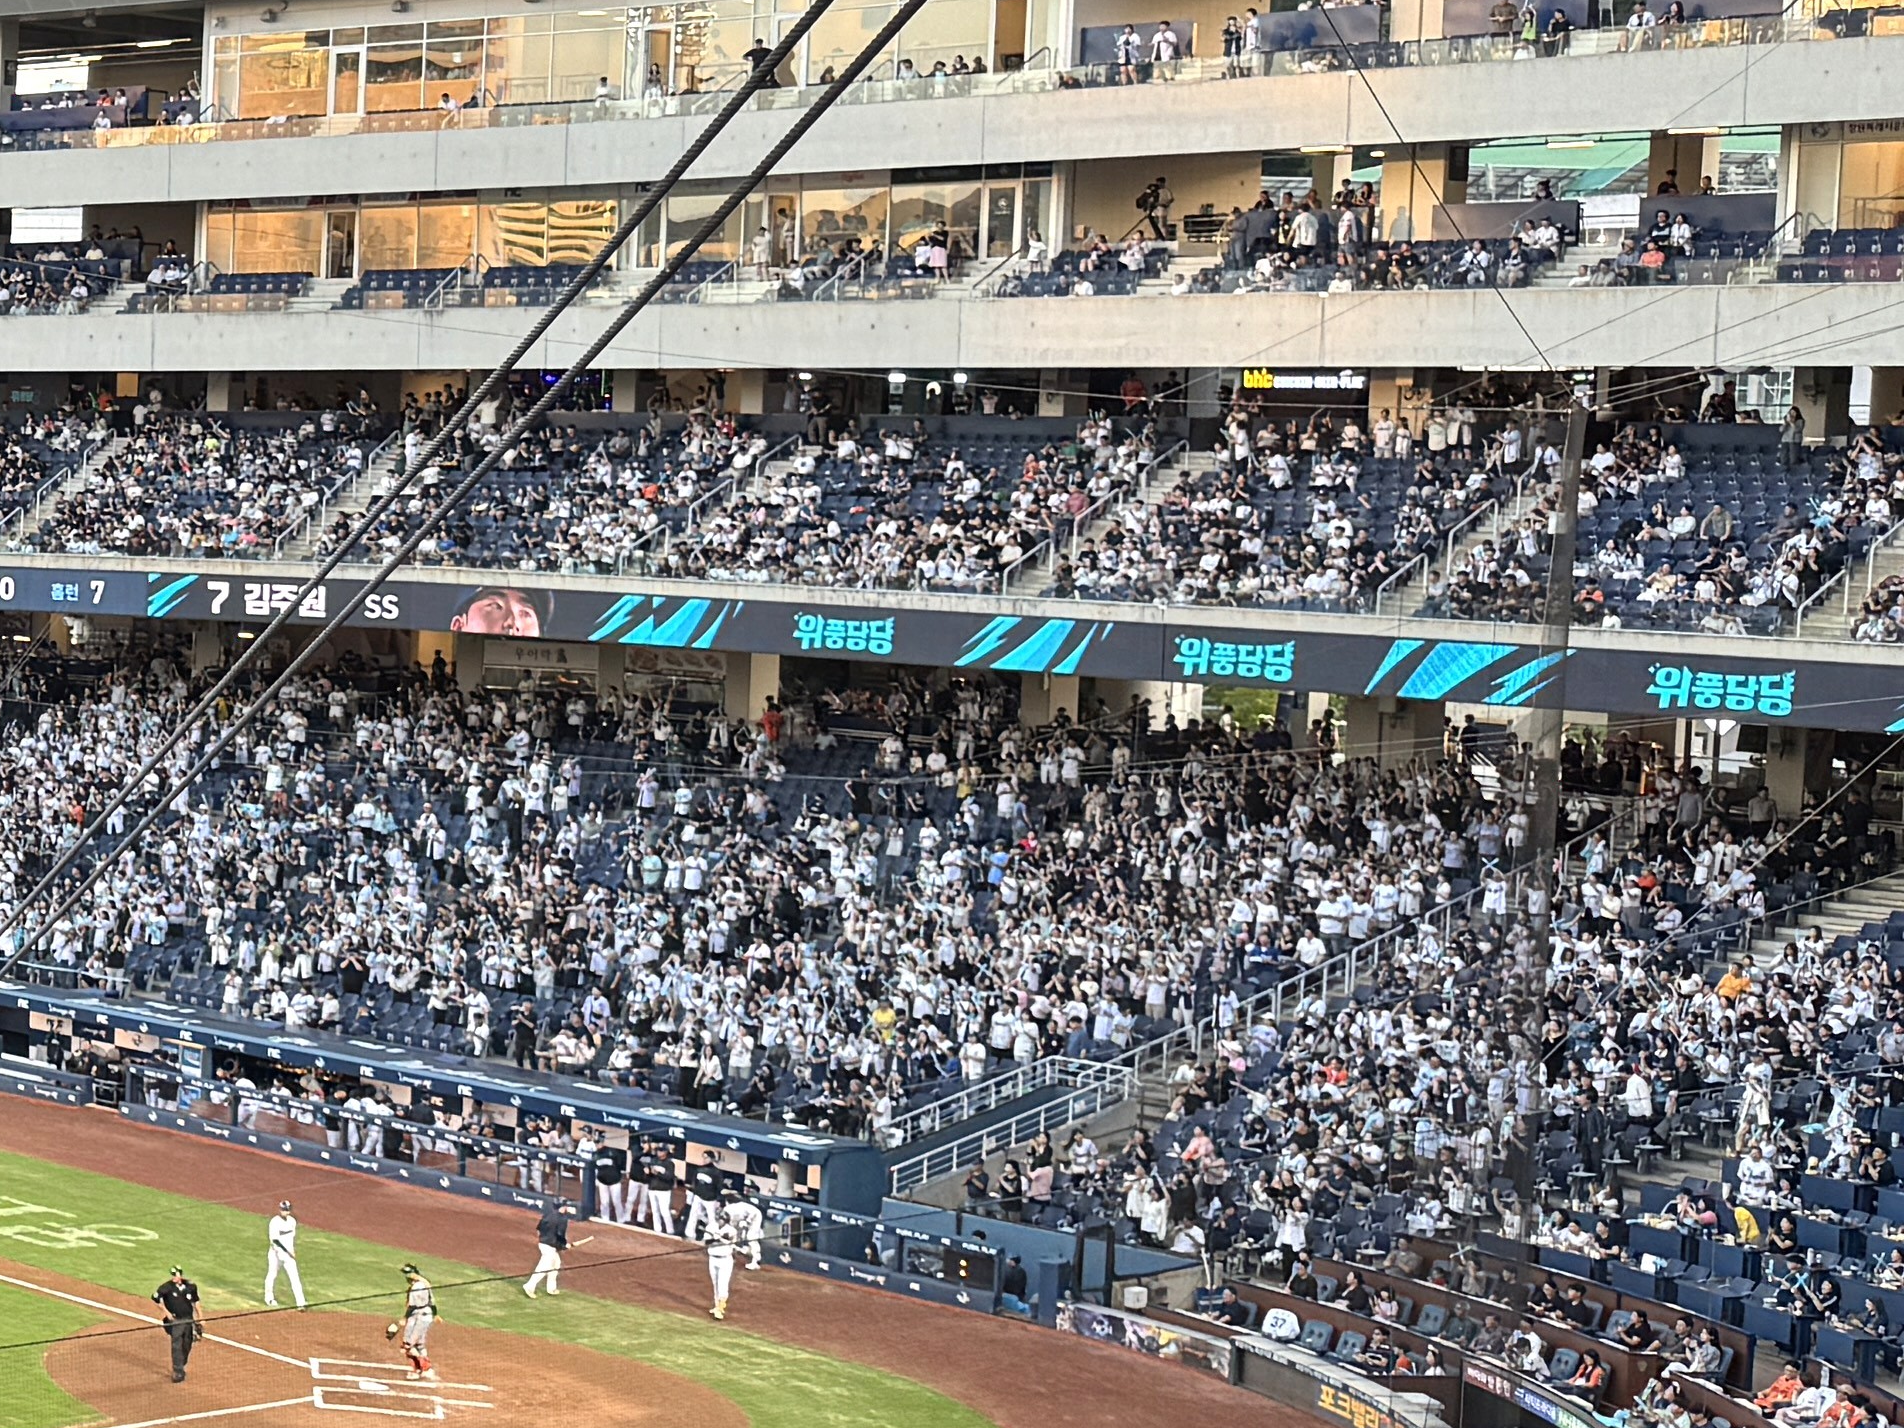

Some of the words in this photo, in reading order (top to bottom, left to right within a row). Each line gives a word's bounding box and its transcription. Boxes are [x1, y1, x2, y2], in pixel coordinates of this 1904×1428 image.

[50, 580, 79, 602] 홈런
[90, 580, 104, 604] 7
[207, 581, 230, 614] 7
[244, 583, 327, 618] 김주원
[364, 594, 399, 619] SS
[793, 612, 894, 655] 위풍당당
[1173, 634, 1295, 683] 위풍당당
[1647, 662, 1796, 715] 위풍당당
[1270, 1316, 1286, 1329] 37
